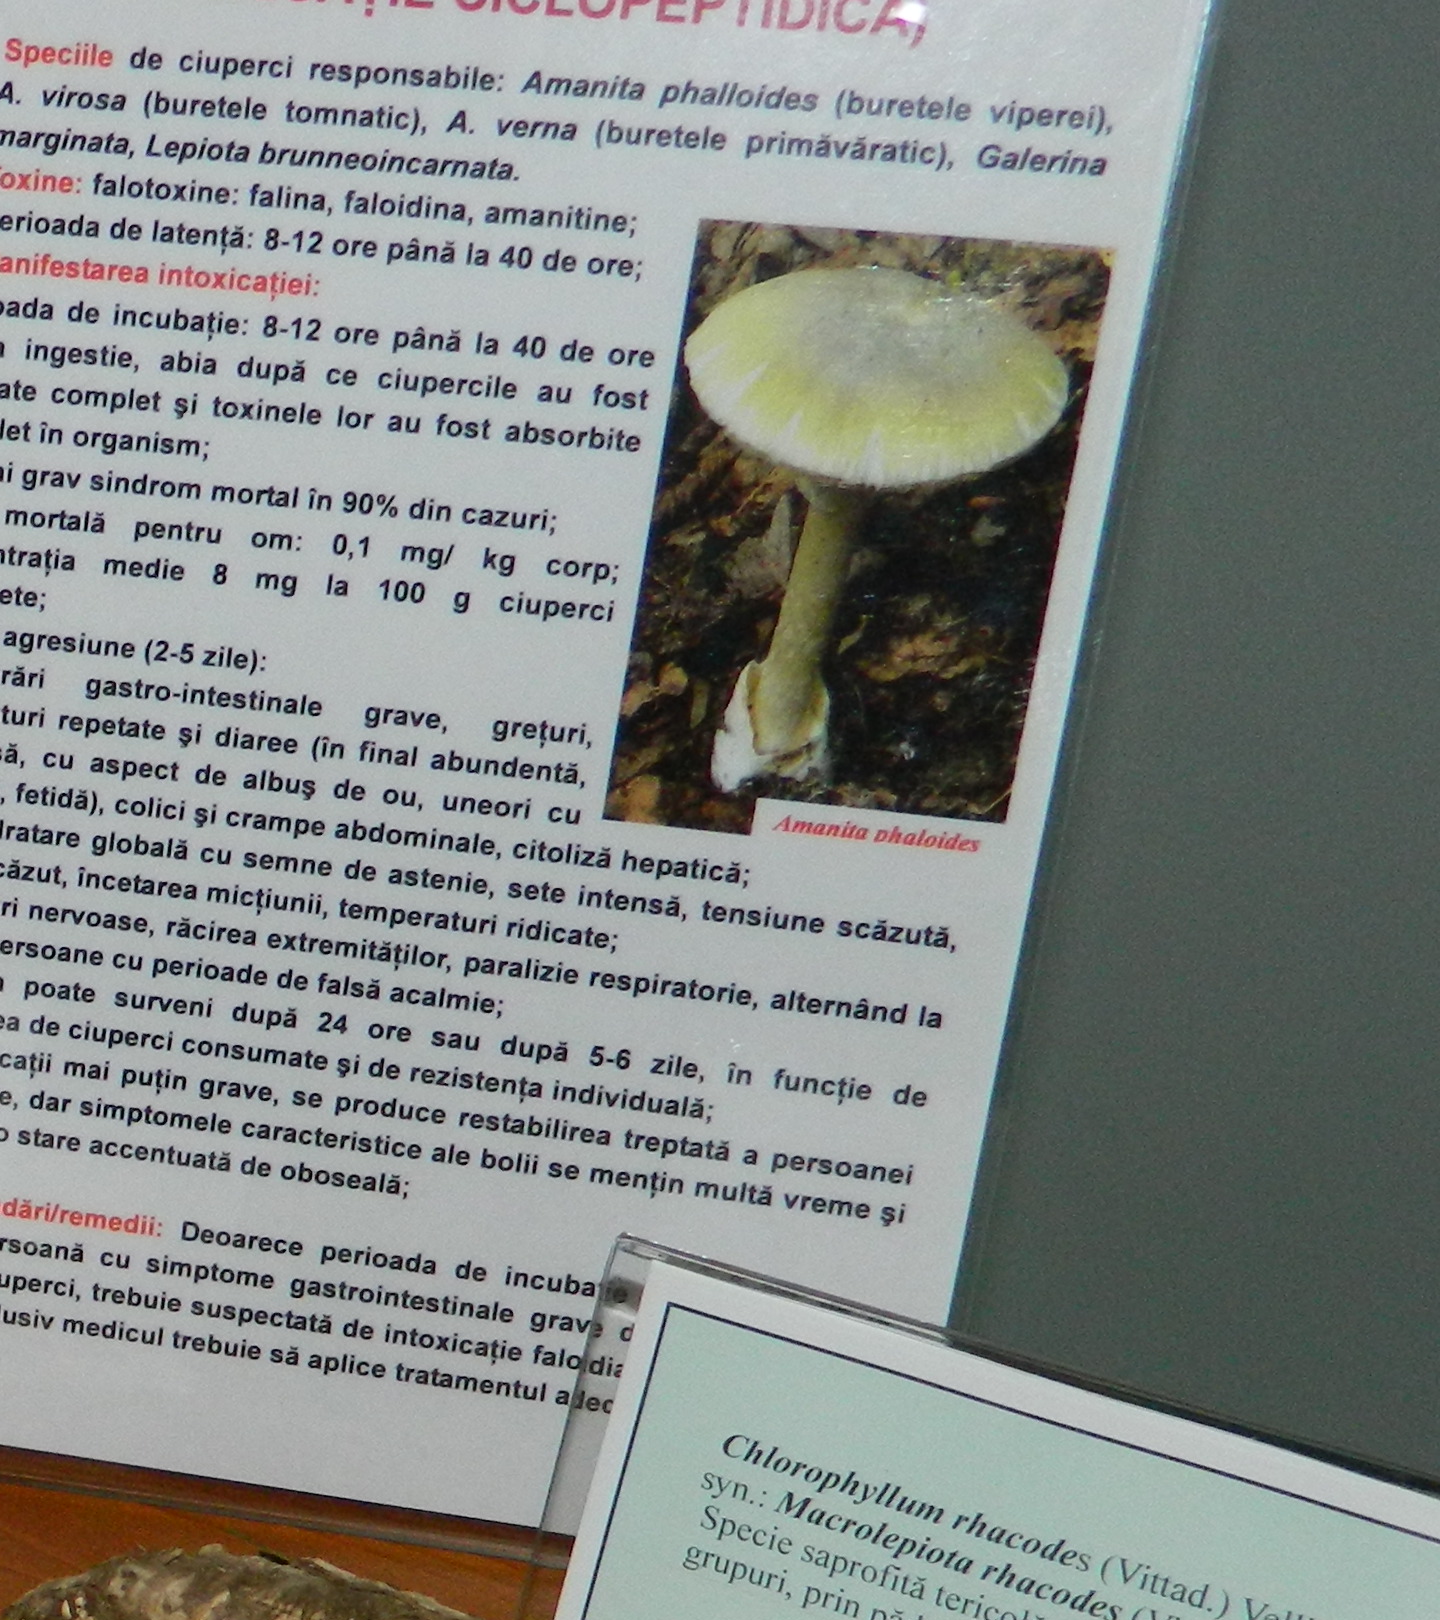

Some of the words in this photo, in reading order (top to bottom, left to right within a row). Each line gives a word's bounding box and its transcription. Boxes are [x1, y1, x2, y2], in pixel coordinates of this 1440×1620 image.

[3, 37, 115, 69] Speciile
[128, 45, 164, 72] de
[177, 49, 294, 81] ciuperci
[308, 61, 505, 93] responsabile:
[519, 69, 647, 102] Amanita
[657, 79, 819, 113] phalloides
[834, 89, 972, 122] (buretele
[989, 99, 1113, 137] viperei),
[41, 83, 128, 113] virosa
[142, 89, 269, 122] (buretele
[284, 99, 428, 137] tomnatic),
[444, 108, 475, 135] A.
[496, 118, 579, 142] verna
[594, 119, 728, 152] (buretele
[743, 130, 955, 172] primăvăratic),
[975, 143, 1109, 178] Galerina
[144, 133, 252, 165] Lepiota
[257, 140, 520, 182] brunneoincarnata.
[773, 814, 869, 840] Amanita
[90, 830, 190, 862] globală
[198, 846, 233, 867] cu
[241, 851, 334, 878] semne
[343, 858, 378, 883] de
[386, 867, 495, 901] astenie,
[506, 880, 567, 905] sete
[576, 884, 688, 923] intensă,
[701, 899, 826, 935] tensiune
[835, 918, 957, 954] scăzută,
[699, 1504, 794, 1556] Specie
[799, 1544, 927, 1602] saprofită
[700, 1471, 768, 1509] syn.:
[773, 1490, 975, 1576] Macrolepiota
[721, 1433, 946, 1525] Chlorophyllum
[950, 1511, 1090, 1573] rhacodes
[1099, 1557, 1231, 1619] (Vittad.)
[681, 1545, 793, 1601] grupuri,
[800, 1584, 861, 1620] prin
